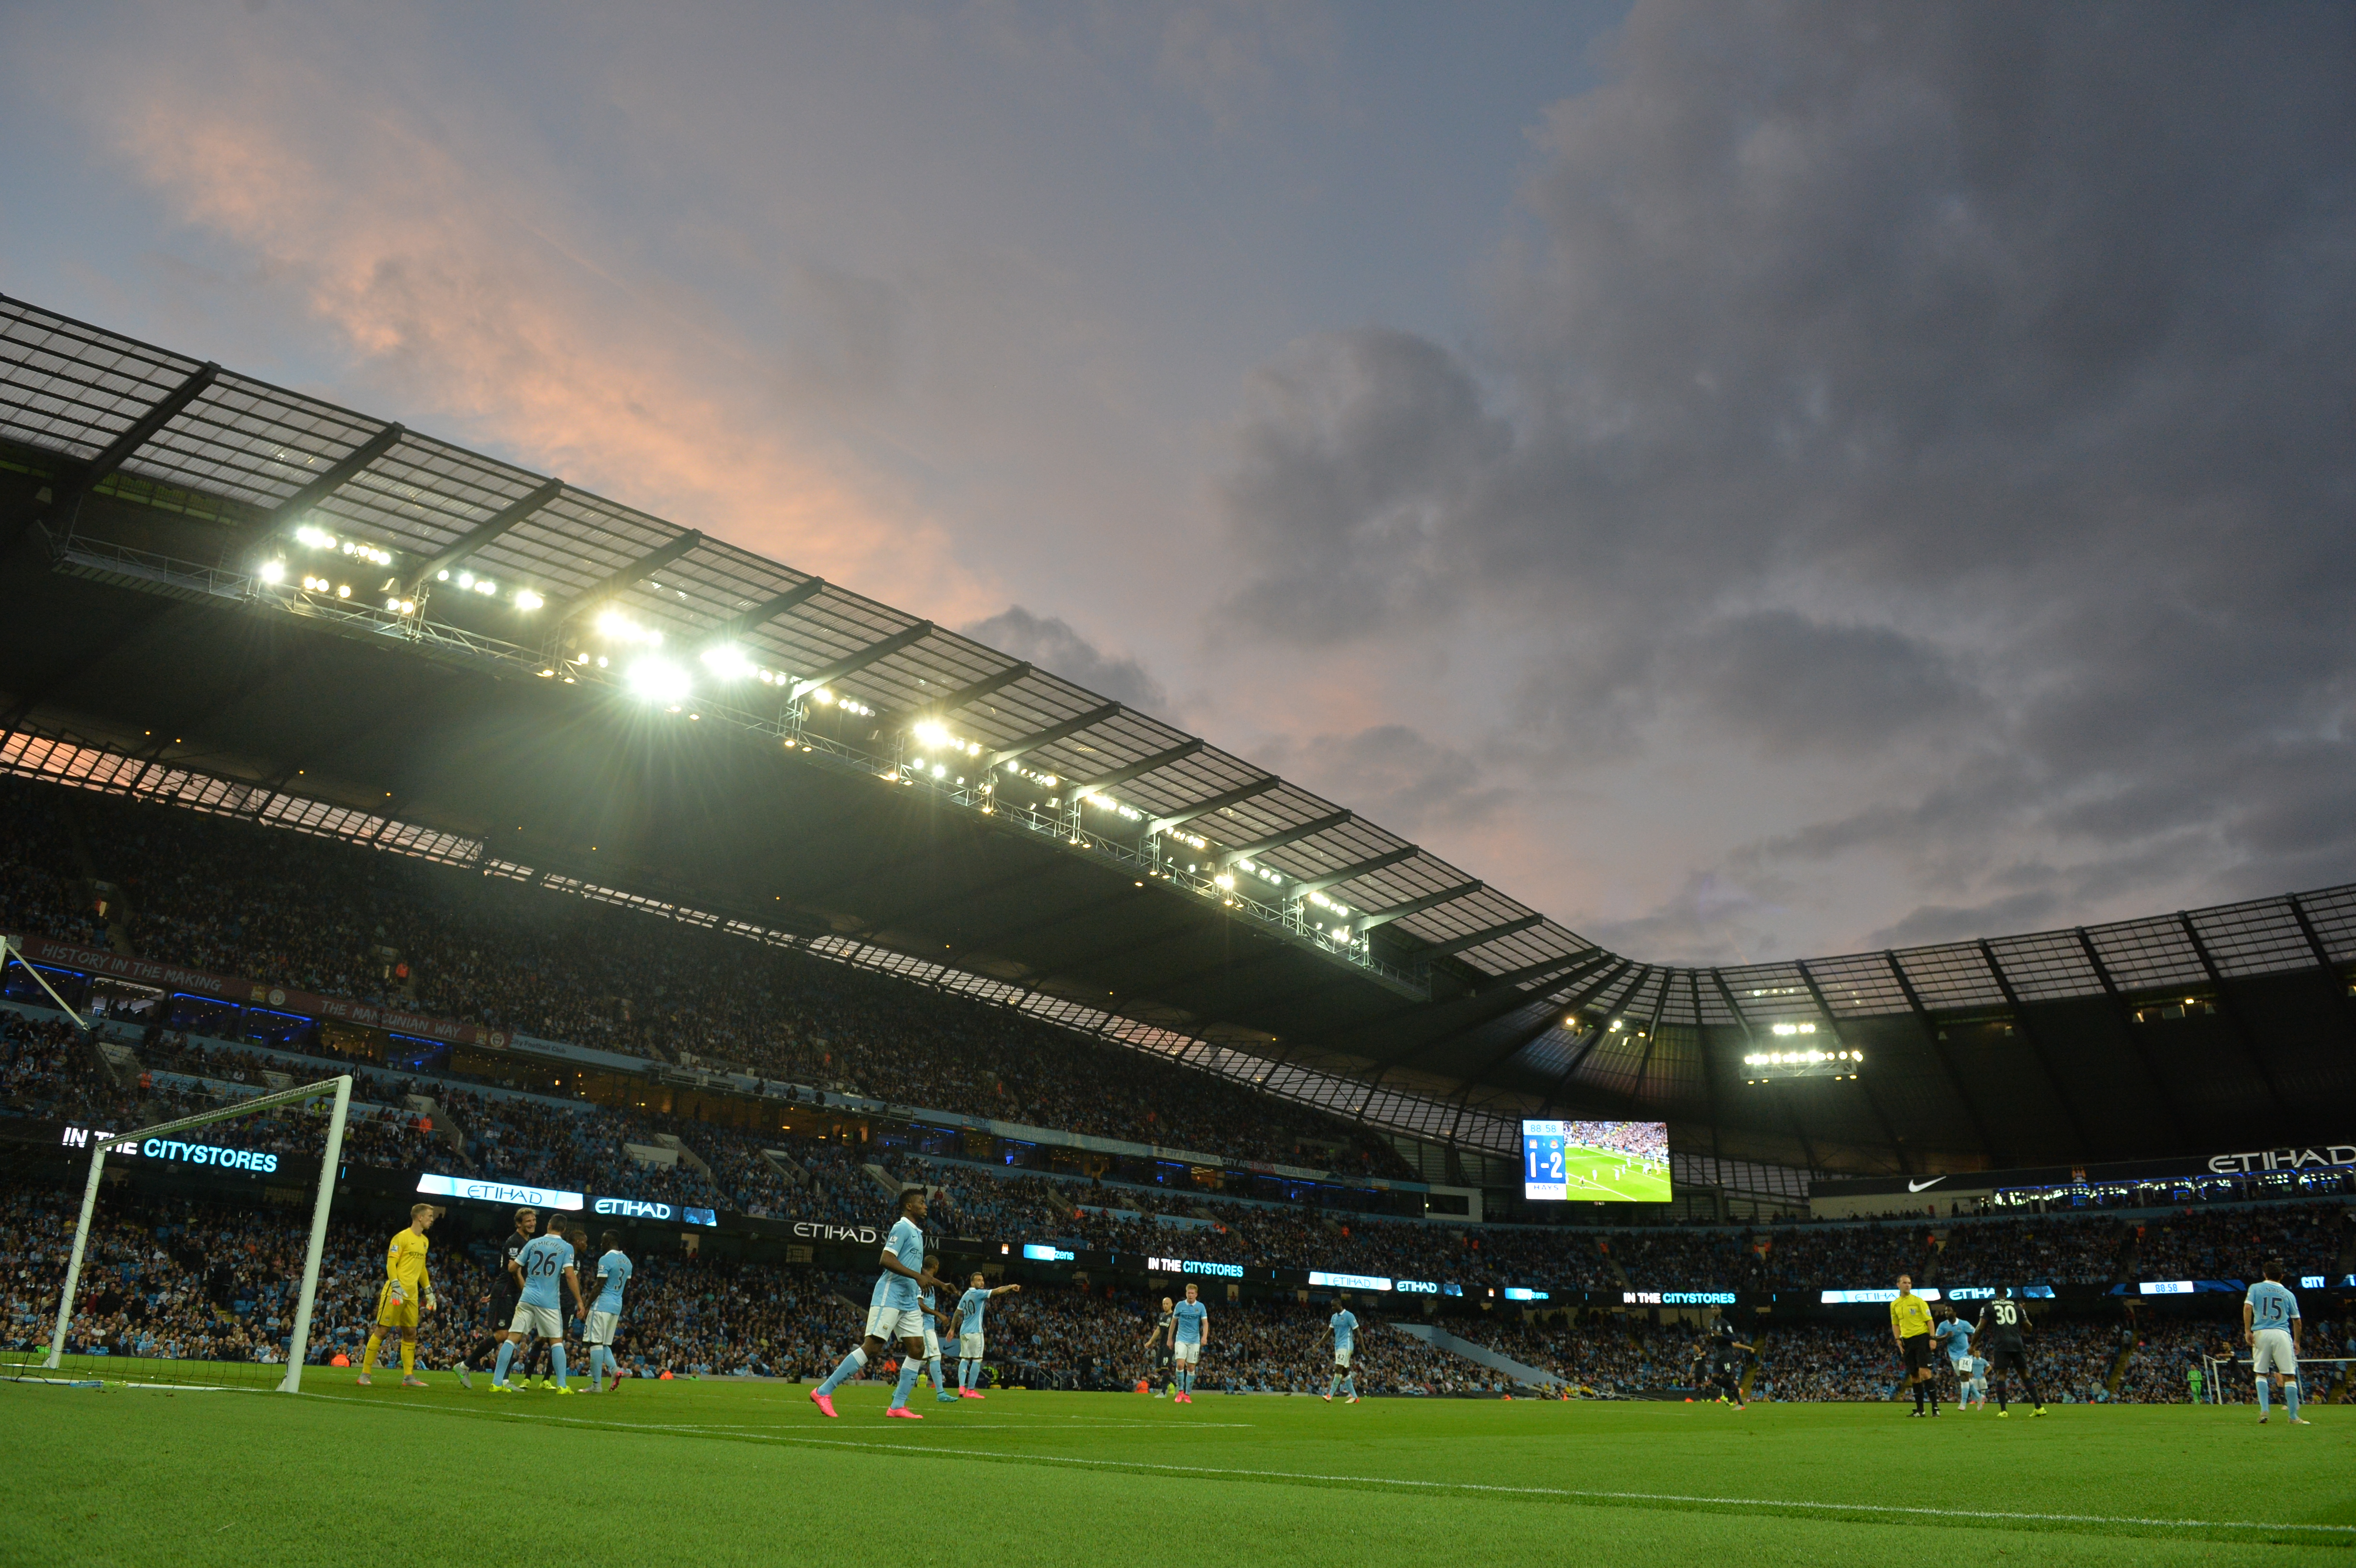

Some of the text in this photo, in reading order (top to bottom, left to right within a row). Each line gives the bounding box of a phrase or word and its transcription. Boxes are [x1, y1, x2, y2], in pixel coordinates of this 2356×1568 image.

[41, 944, 222, 992] HISTORY IN THE MAKING
[321, 1001, 347, 1015] THE
[434, 1023, 461, 1038] WAY
[62, 1127, 88, 1148] IN
[144, 1139, 277, 1172] CITYSTORES
[2208, 1145, 2356, 1174] ETIHAD
[1222, 1157, 1237, 1166] CITY
[1239, 1160, 1253, 1168] ARE
[468, 1186, 542, 1204] ETIHAD
[595, 1198, 670, 1219] ETIHAD
[794, 1222, 876, 1243] ETIHAD
[531, 1251, 557, 1277] 26
[1148, 1257, 1243, 1277] IN THE CITYSTORES
[614, 1268, 624, 1291] 3
[1333, 1277, 1371, 1287] ETIHAD
[1397, 1281, 1437, 1293] ETIHAD
[2155, 1284, 2178, 1292] 88:58
[2301, 1276, 2324, 1288] CITY
[1624, 1292, 1735, 1304] IN THE CITYSTORES
[1855, 1293, 1900, 1301] ETIHA
[963, 1299, 976, 1317] 30
[1994, 1305, 2017, 1325] 30
[2262, 1297, 2282, 1321] 15
[1163, 1357, 1168, 1366] 19
